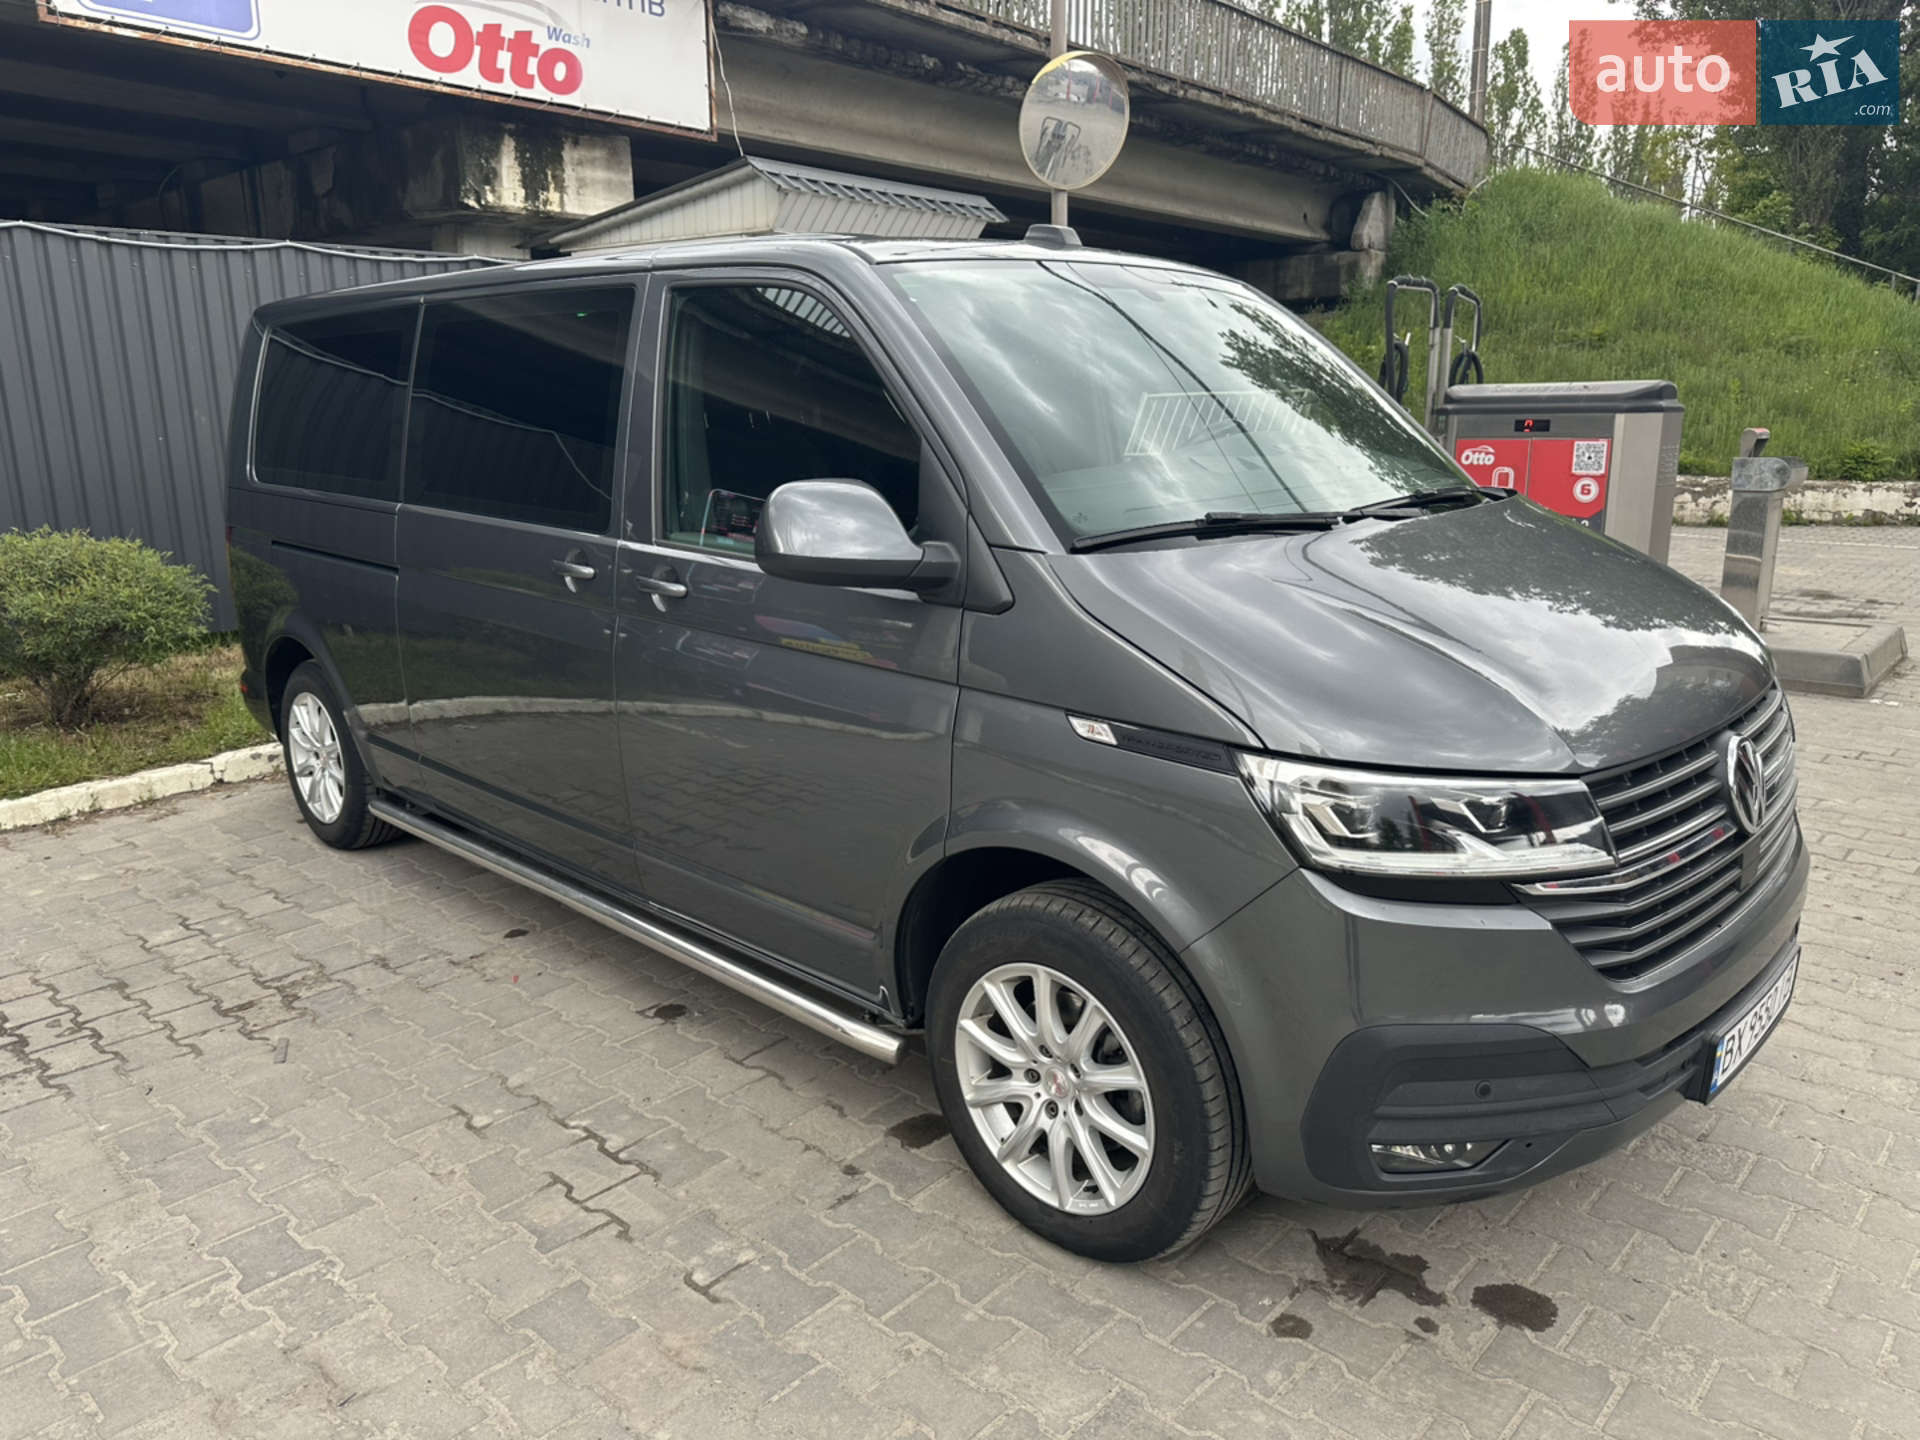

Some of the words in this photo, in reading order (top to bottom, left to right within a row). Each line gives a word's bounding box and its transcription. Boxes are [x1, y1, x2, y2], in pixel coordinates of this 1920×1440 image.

[546, 25, 591, 48] Wash
[407, 4, 583, 95] Otto
[1461, 451, 1495, 465] Otto
[1580, 484, 1592, 495] 6
[1120, 733, 1222, 761] TRANSPORTER
